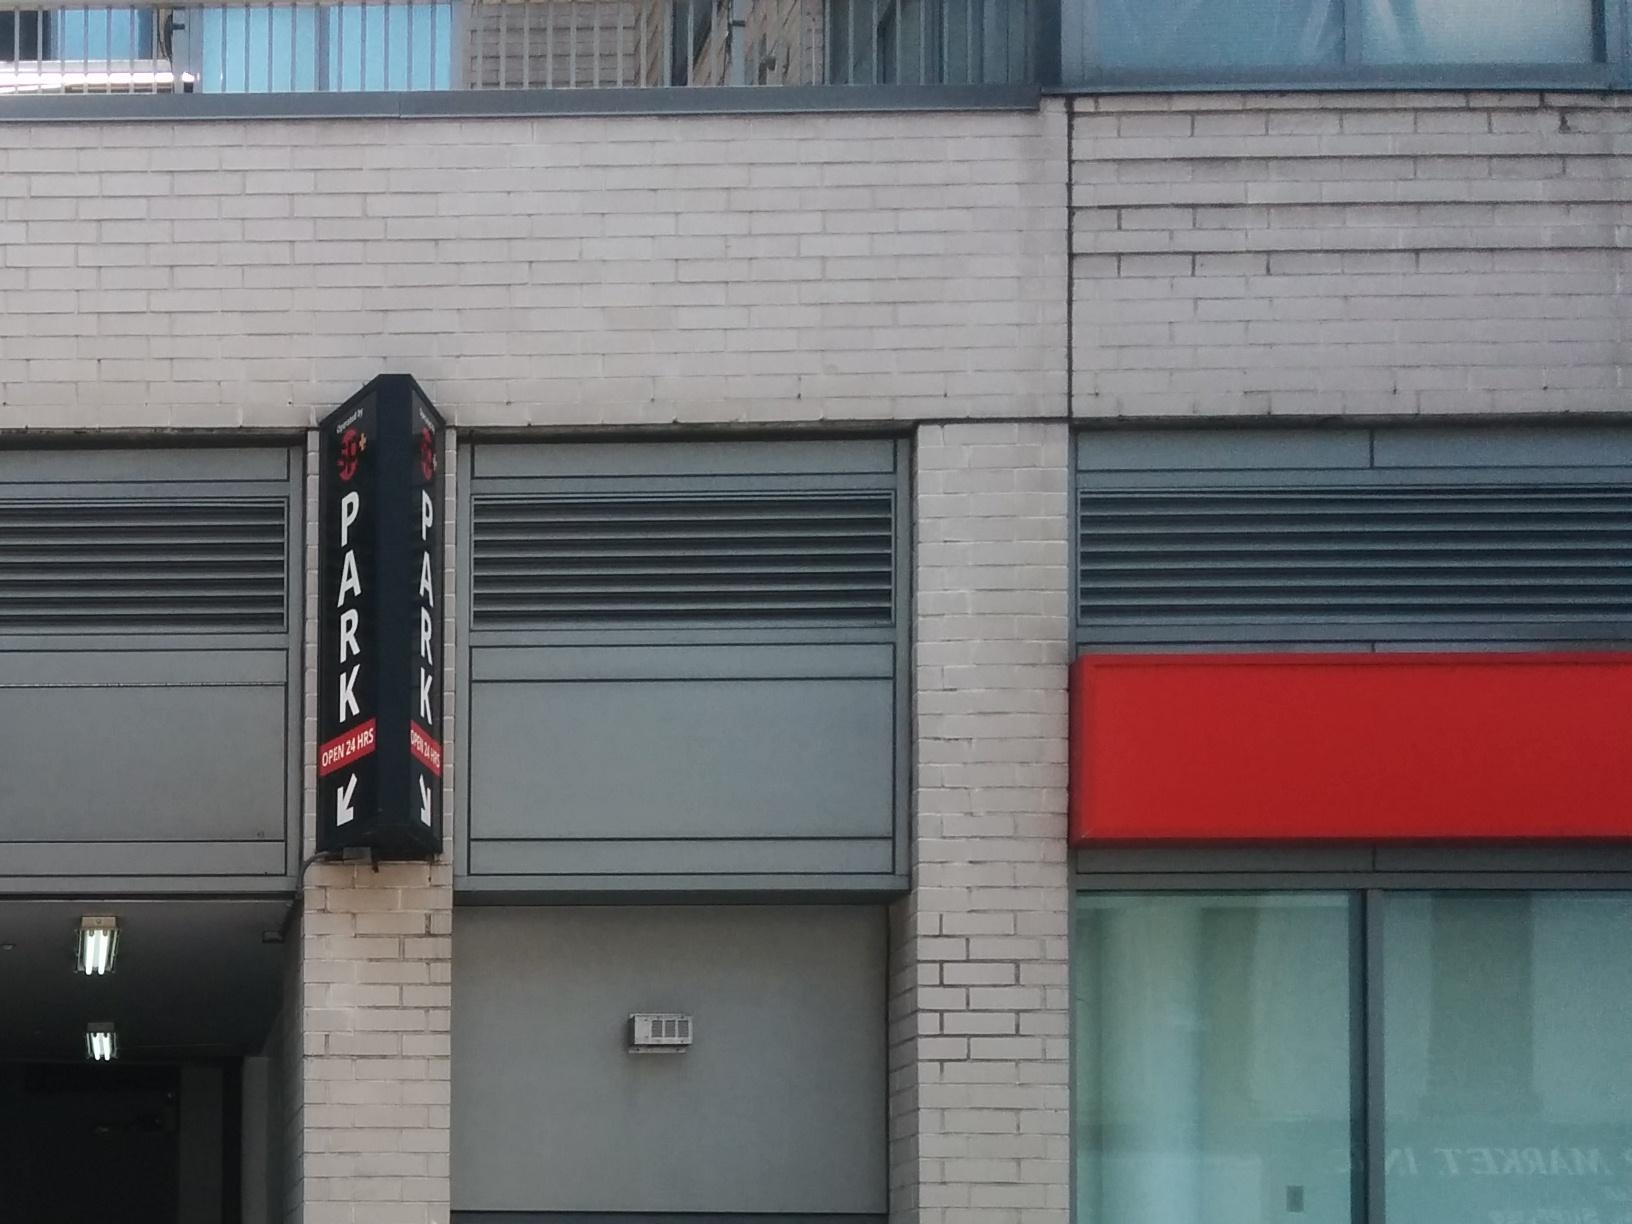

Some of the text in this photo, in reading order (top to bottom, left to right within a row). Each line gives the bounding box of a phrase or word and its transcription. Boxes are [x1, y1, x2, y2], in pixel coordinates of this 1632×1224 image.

[337, 491, 362, 723] PARK
[419, 489, 434, 726] PARK
[321, 727, 374, 767] OPEN 24 HRS
[410, 729, 424, 753] OPEN
[430, 748, 441, 769] HRS
